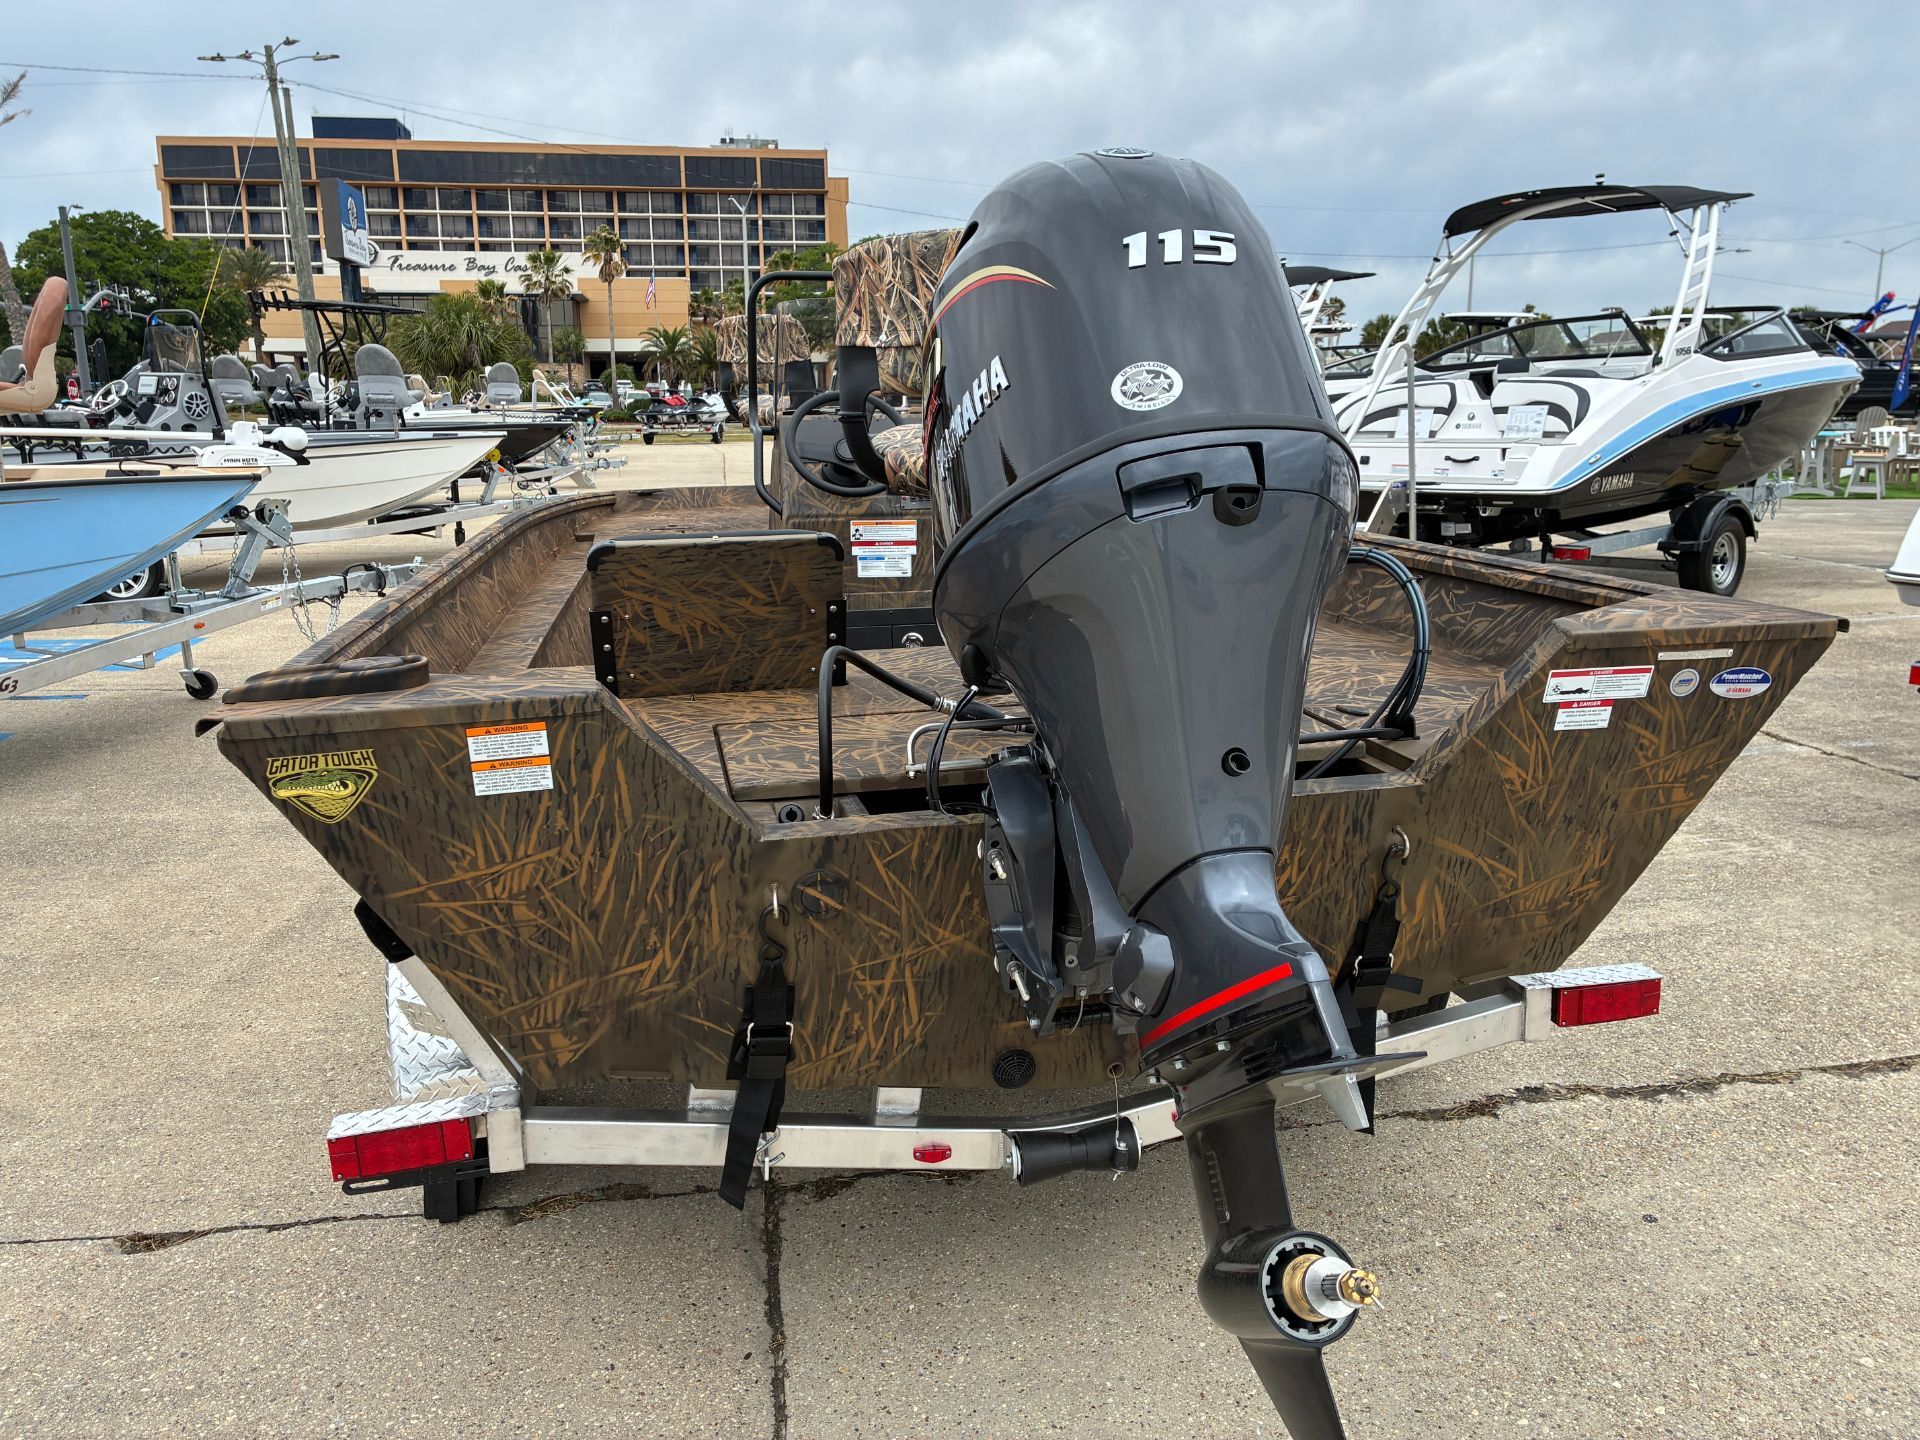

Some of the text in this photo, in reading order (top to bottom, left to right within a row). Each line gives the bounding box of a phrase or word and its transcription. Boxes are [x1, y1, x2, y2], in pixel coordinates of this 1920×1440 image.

[1123, 229, 1237, 268] 115
[387, 254, 530, 276] Treasure Bay Cas
[1601, 472, 1635, 492] YAMAHA
[493, 725, 529, 733] WARNING
[268, 750, 375, 775] GATOR TOUGH
[498, 759, 534, 768] WARNING
